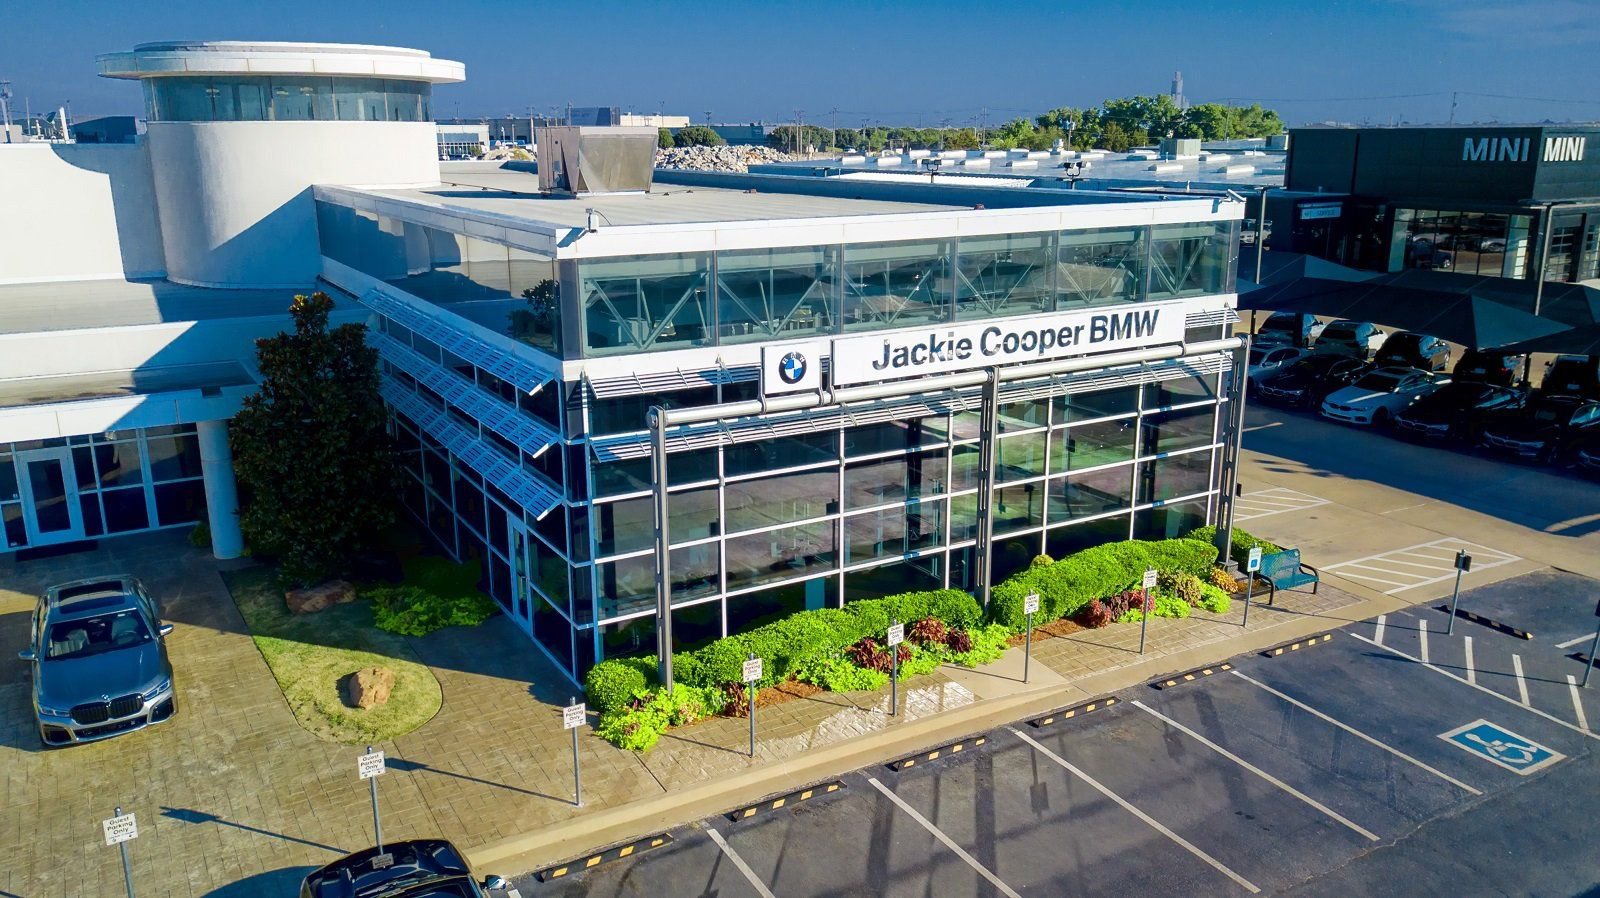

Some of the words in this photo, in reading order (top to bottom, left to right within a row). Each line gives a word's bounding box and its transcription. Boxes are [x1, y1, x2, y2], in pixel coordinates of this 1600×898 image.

[1462, 137, 1530, 161] MINI
[1543, 136, 1586, 161] MINI
[872, 331, 973, 371] Jackie
[980, 325, 1085, 356] Cooper
[1089, 309, 1160, 344] BMW
[360, 758, 382, 767] Parking
[362, 754, 379, 762] Guest
[107, 821, 133, 831] Parking
[109, 816, 129, 826] Guest
[113, 827, 128, 835] Only
